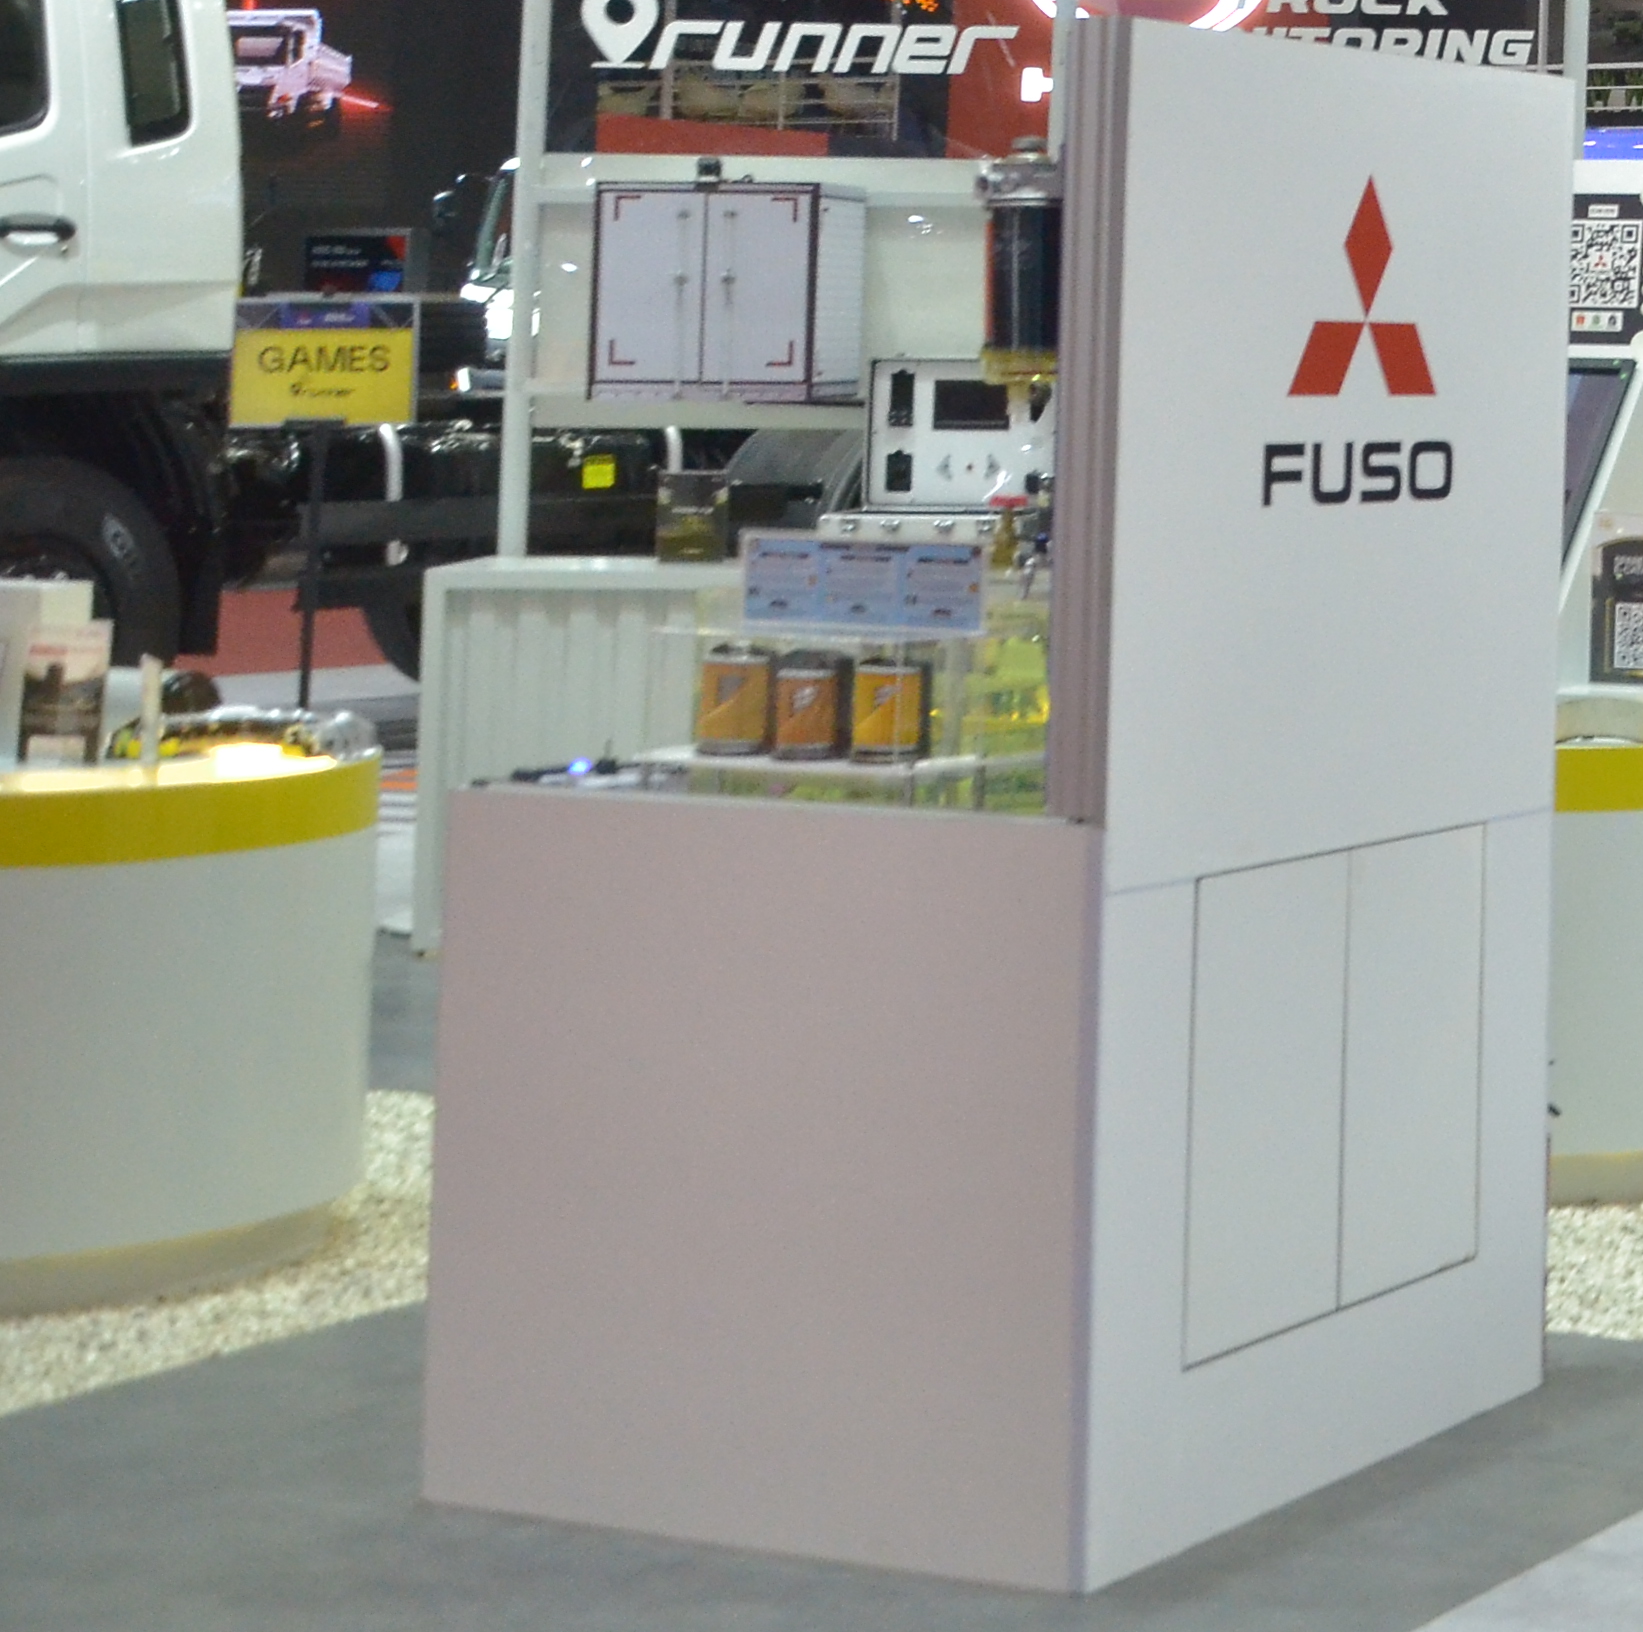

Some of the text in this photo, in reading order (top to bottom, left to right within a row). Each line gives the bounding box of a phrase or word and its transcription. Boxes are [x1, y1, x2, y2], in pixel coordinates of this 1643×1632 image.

[649, 18, 1020, 76] runner
[257, 344, 392, 375] GAMES
[1262, 439, 1454, 507] FUSO
